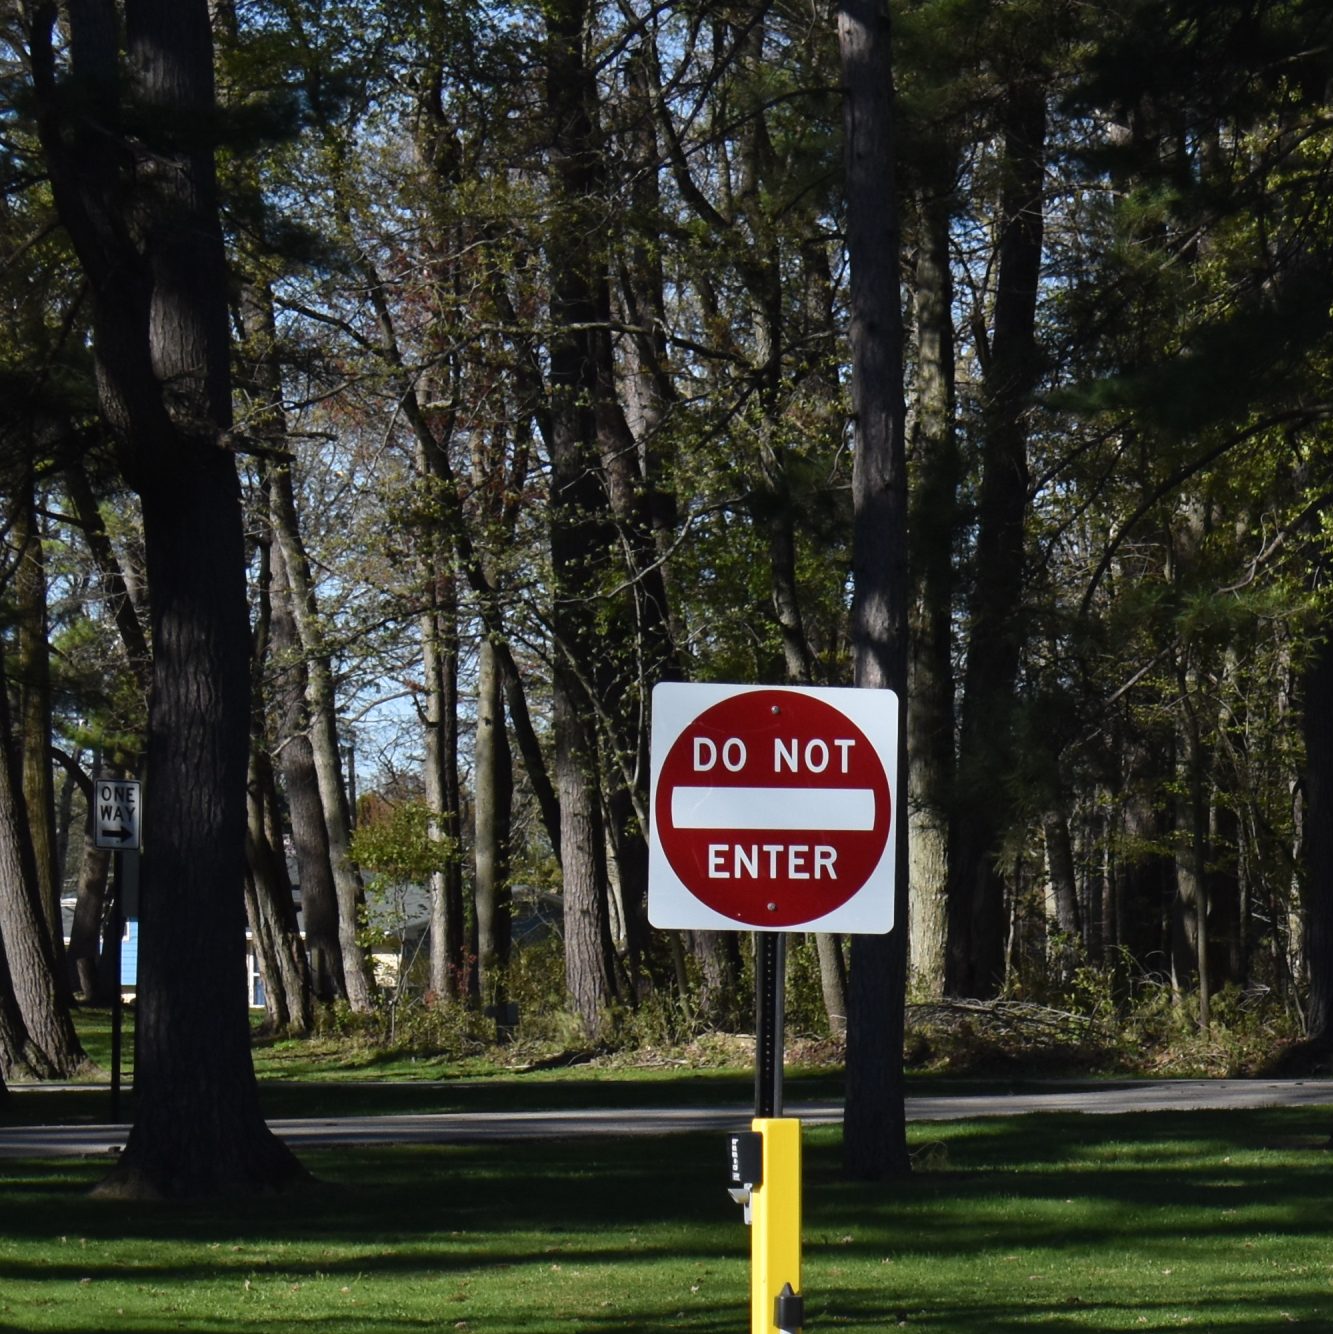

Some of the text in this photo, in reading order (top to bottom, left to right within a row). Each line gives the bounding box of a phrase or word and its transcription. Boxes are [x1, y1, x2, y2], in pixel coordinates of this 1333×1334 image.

[693, 737, 856, 773] DO NOT
[101, 786, 135, 803] ONE
[100, 805, 136, 822] WAY
[708, 844, 838, 880] ENTER
